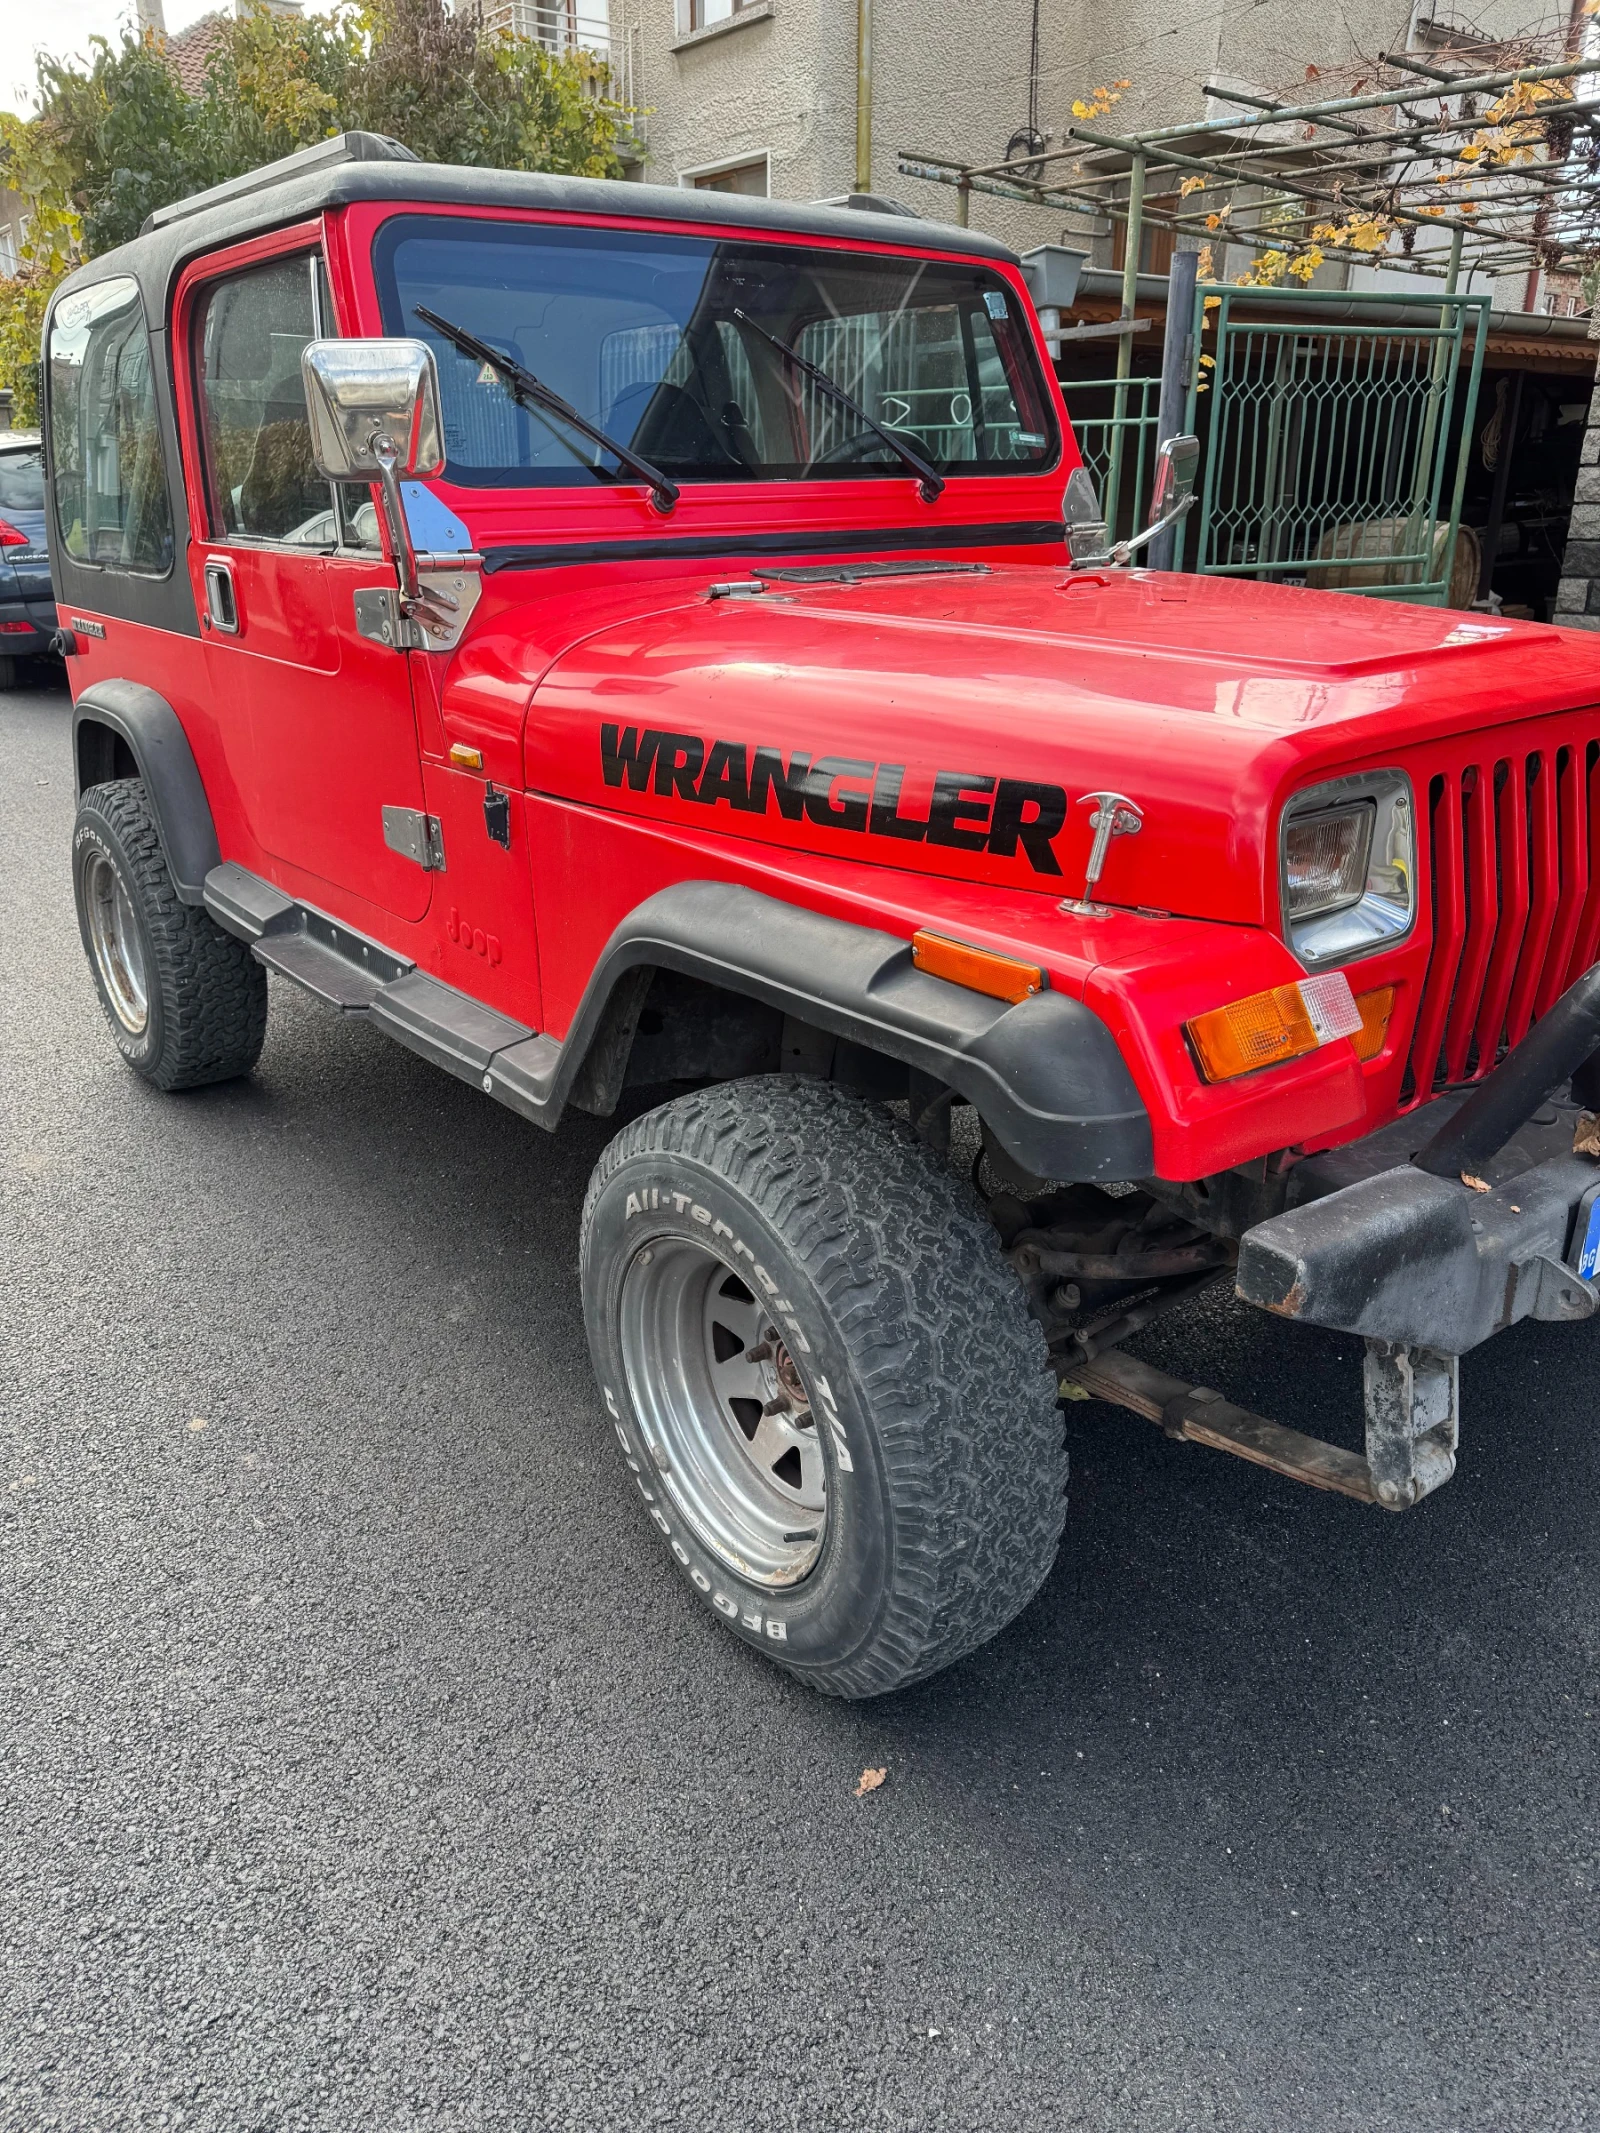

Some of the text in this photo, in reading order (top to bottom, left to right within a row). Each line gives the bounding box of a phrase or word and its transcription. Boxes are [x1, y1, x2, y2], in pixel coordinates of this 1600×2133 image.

[601, 723, 1067, 876] WRANGLER
[625, 1188, 811, 1353] All-Terrain
[1581, 1248, 1597, 1273] BG
